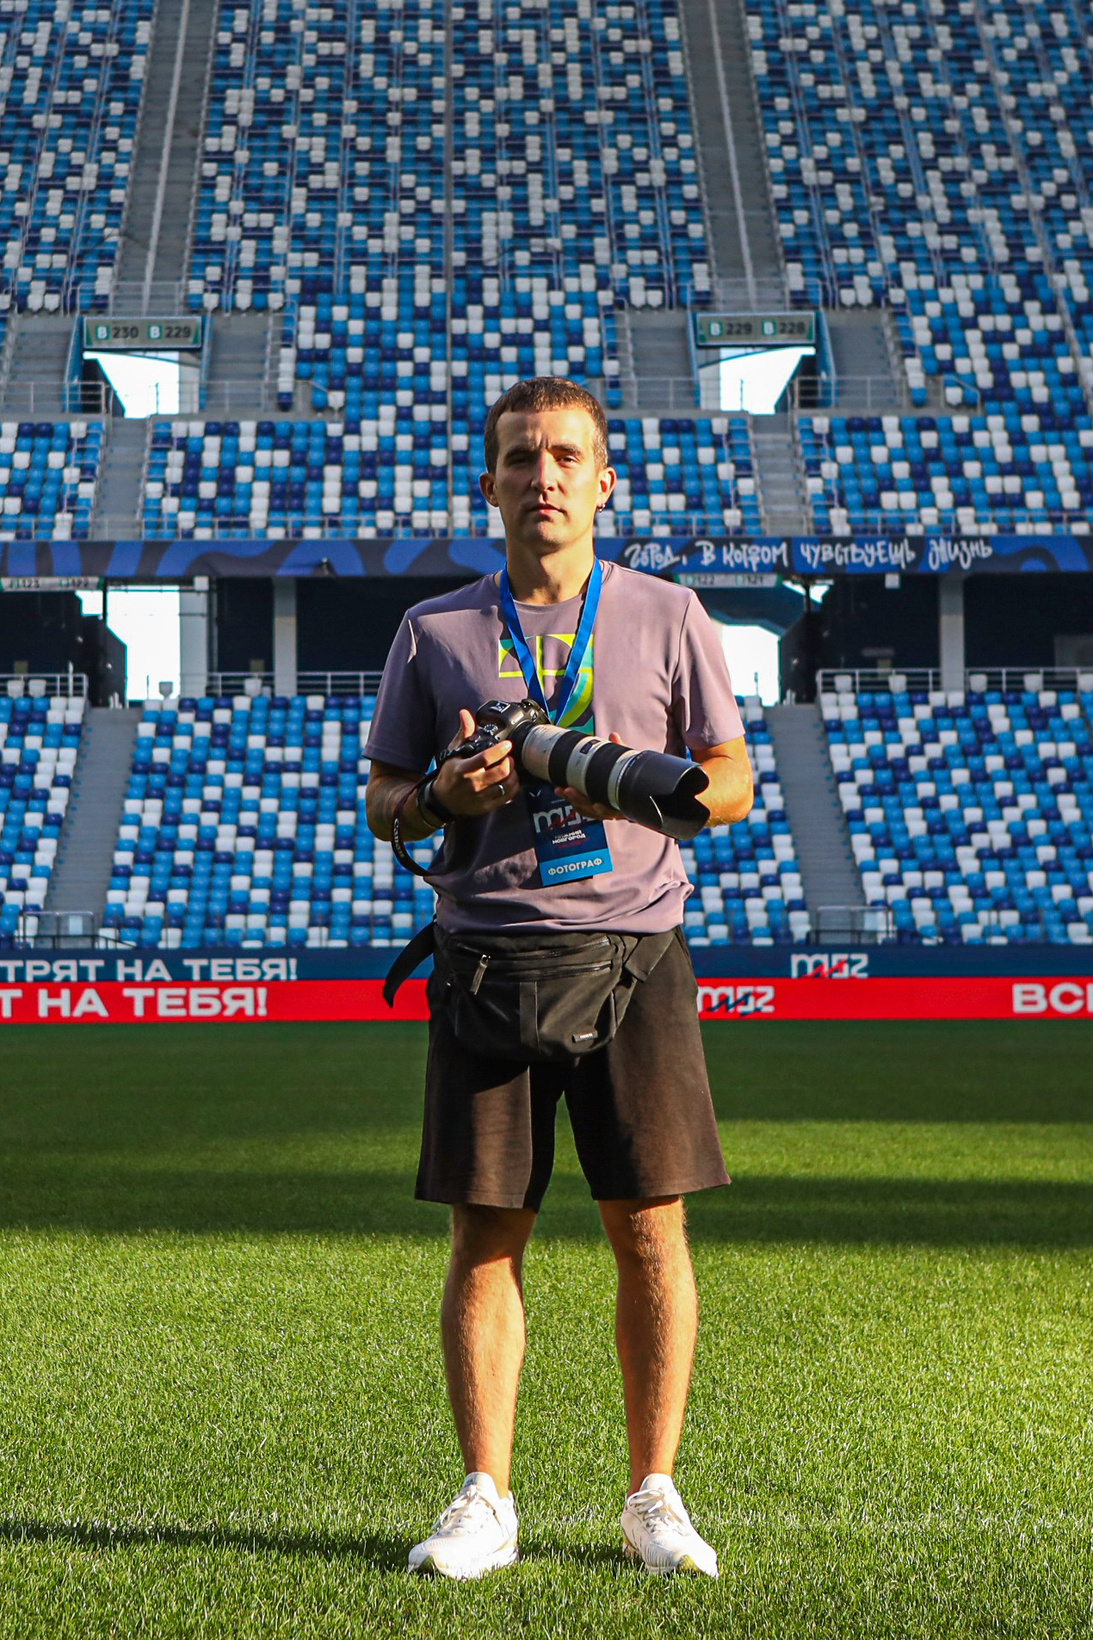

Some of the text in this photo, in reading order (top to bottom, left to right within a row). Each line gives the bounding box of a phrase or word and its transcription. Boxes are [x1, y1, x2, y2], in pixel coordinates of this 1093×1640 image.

[112, 326, 139, 339] 230
[165, 326, 191, 339] 229
[726, 322, 752, 335] 229
[548, 857, 603, 876] ФОТОГРАФ
[0, 958, 297, 982] ТРЯТ НА ТЕБЯ!
[38, 988, 109, 1017] НА
[122, 987, 268, 1017] ТЕБЯ!
